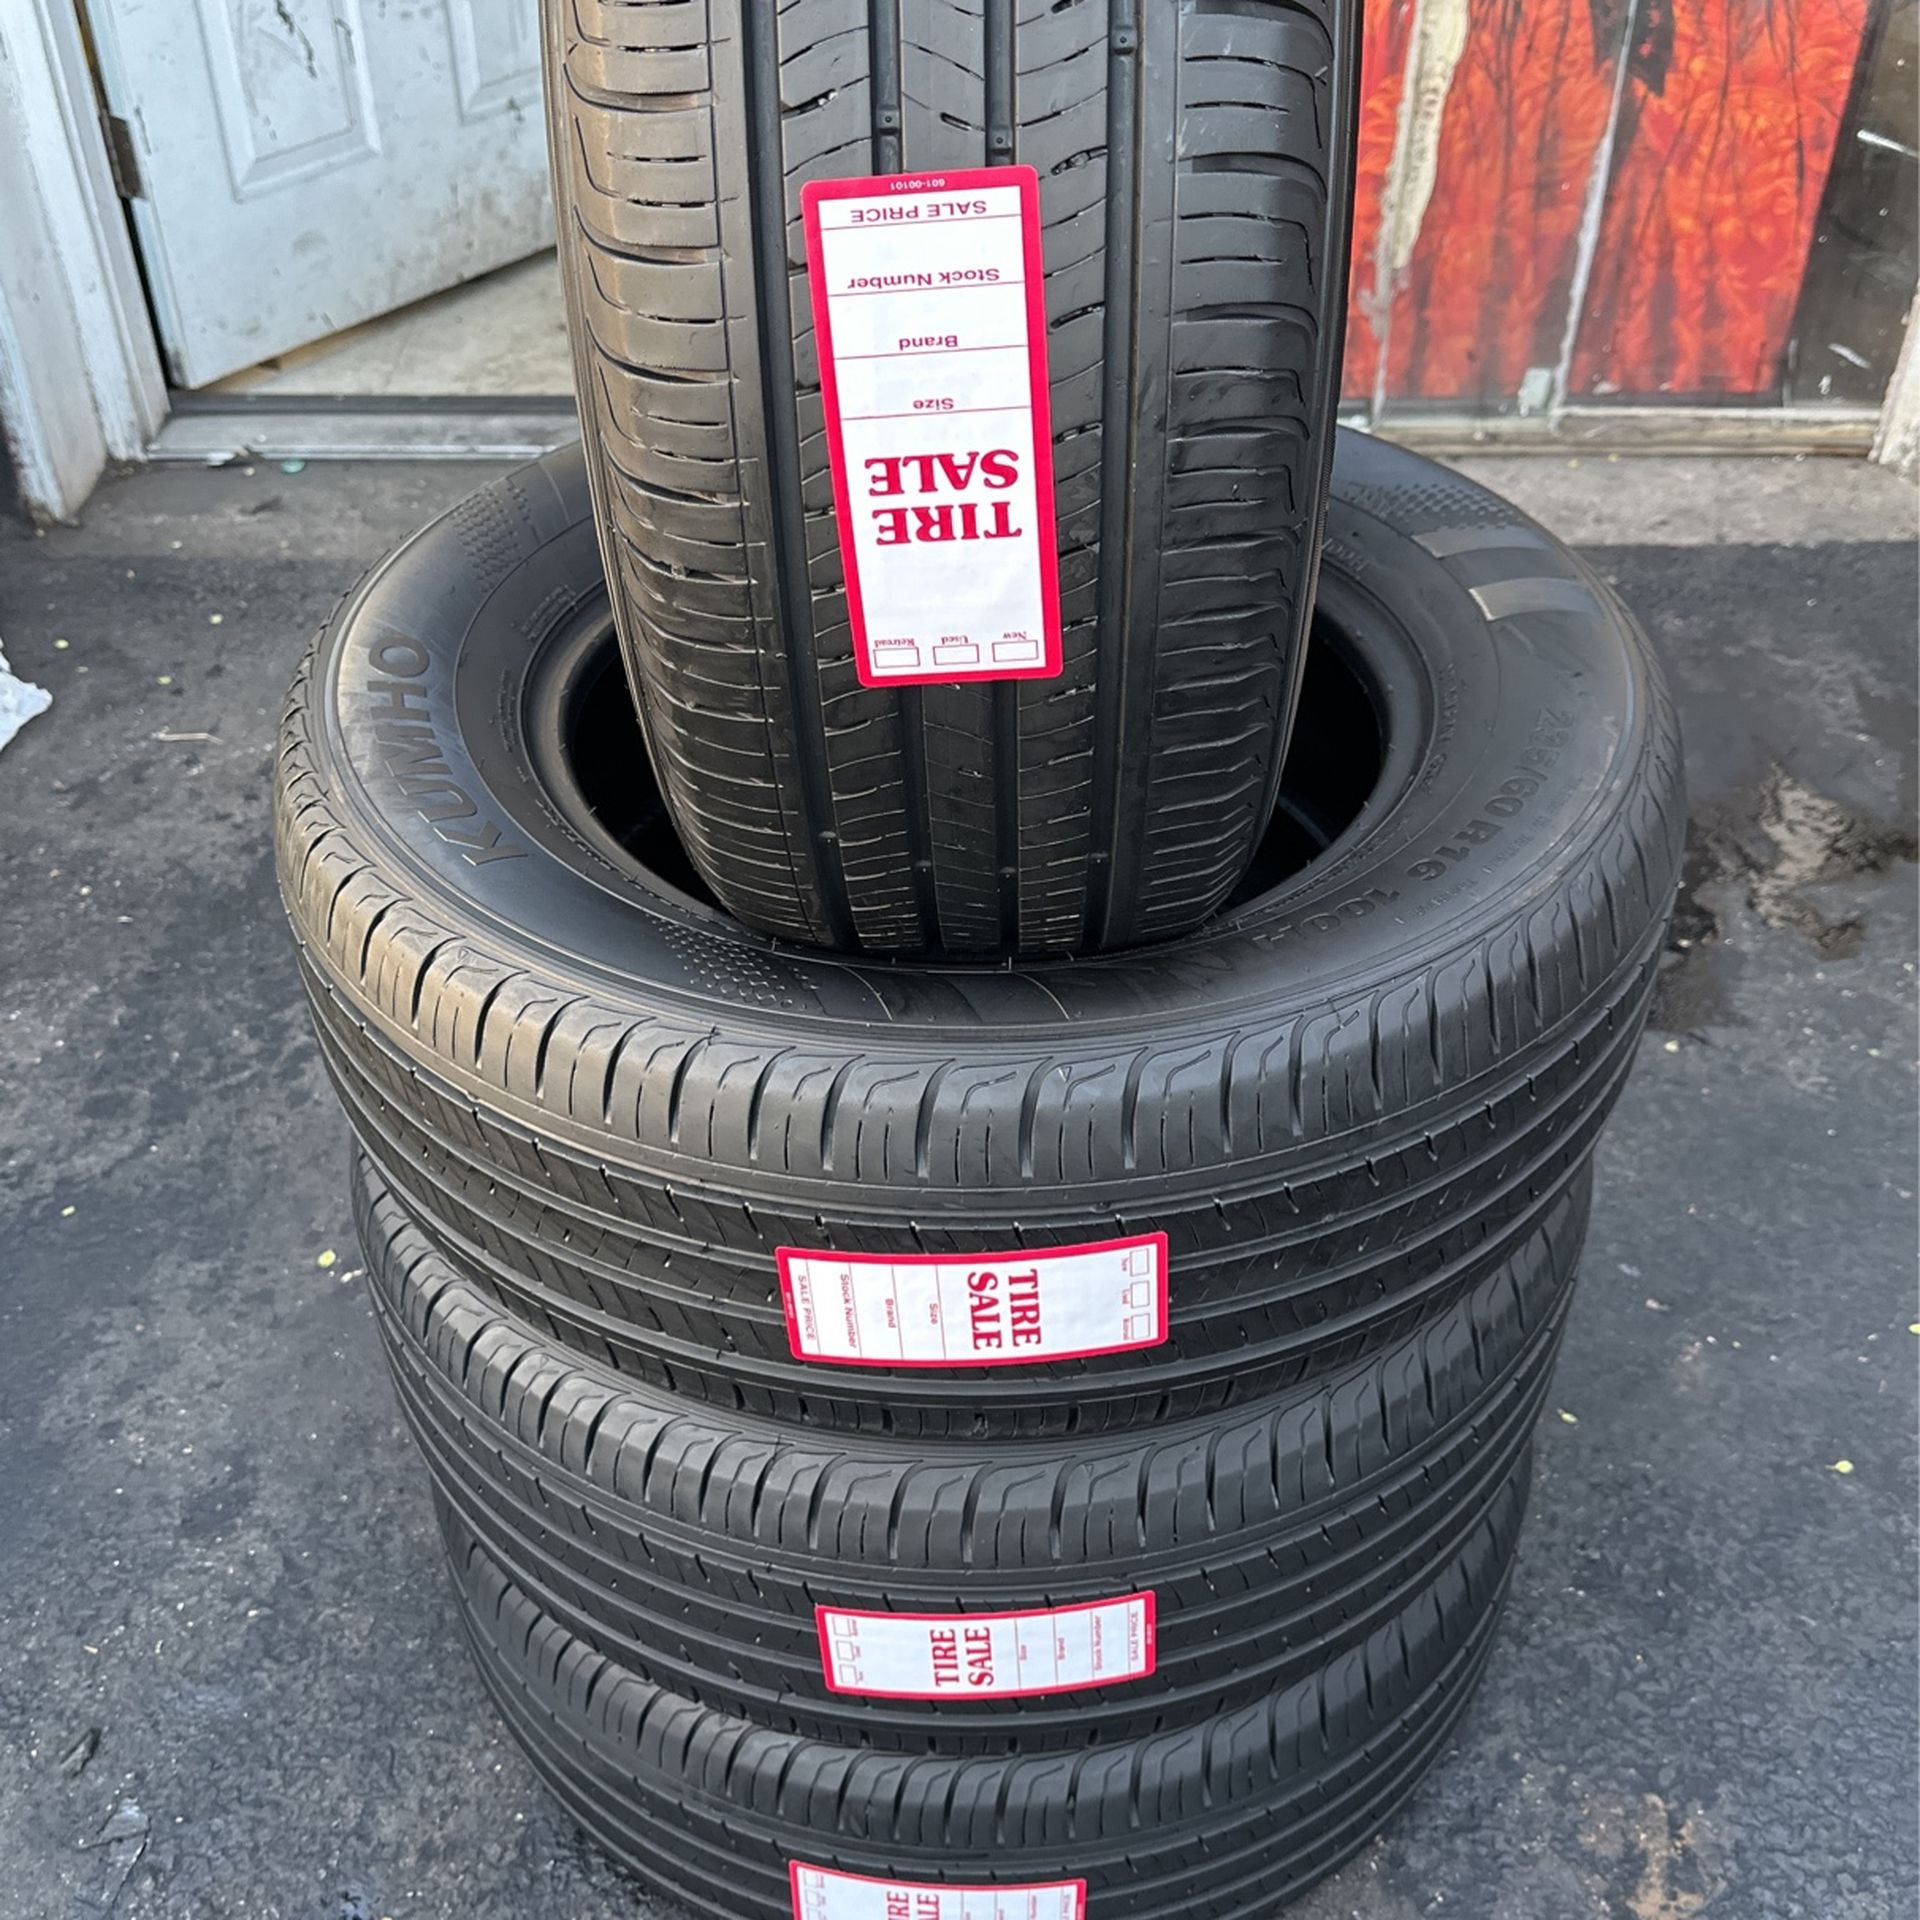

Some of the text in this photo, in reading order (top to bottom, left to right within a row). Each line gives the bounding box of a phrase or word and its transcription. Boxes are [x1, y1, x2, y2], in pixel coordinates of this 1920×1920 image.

[890, 178, 945, 191] 601-00101
[851, 200, 987, 223] SALE PRICE
[847, 268, 1000, 289] Stock Number
[899, 335, 958, 351] Brand
[913, 397, 954, 411] Size
[864, 449, 1019, 497] SALE
[872, 501, 1022, 546] TIRE
[874, 637, 915, 648] Retread
[941, 635, 969, 646] Used
[1003, 630, 1027, 641] New
[366, 634, 529, 867] KUMHO
[1406, 818, 1500, 883] R16
[798, 1275, 815, 1340] SALE PRICE
[840, 1273, 857, 1348] Stock Number
[885, 1298, 896, 1329] Brand
[929, 1302, 938, 1325] Size
[967, 1271, 1002, 1350] SALE
[1008, 1268, 1042, 1348] TIRE
[930, 1628, 960, 1687] TIRE
[964, 1627, 994, 1686] SALE
